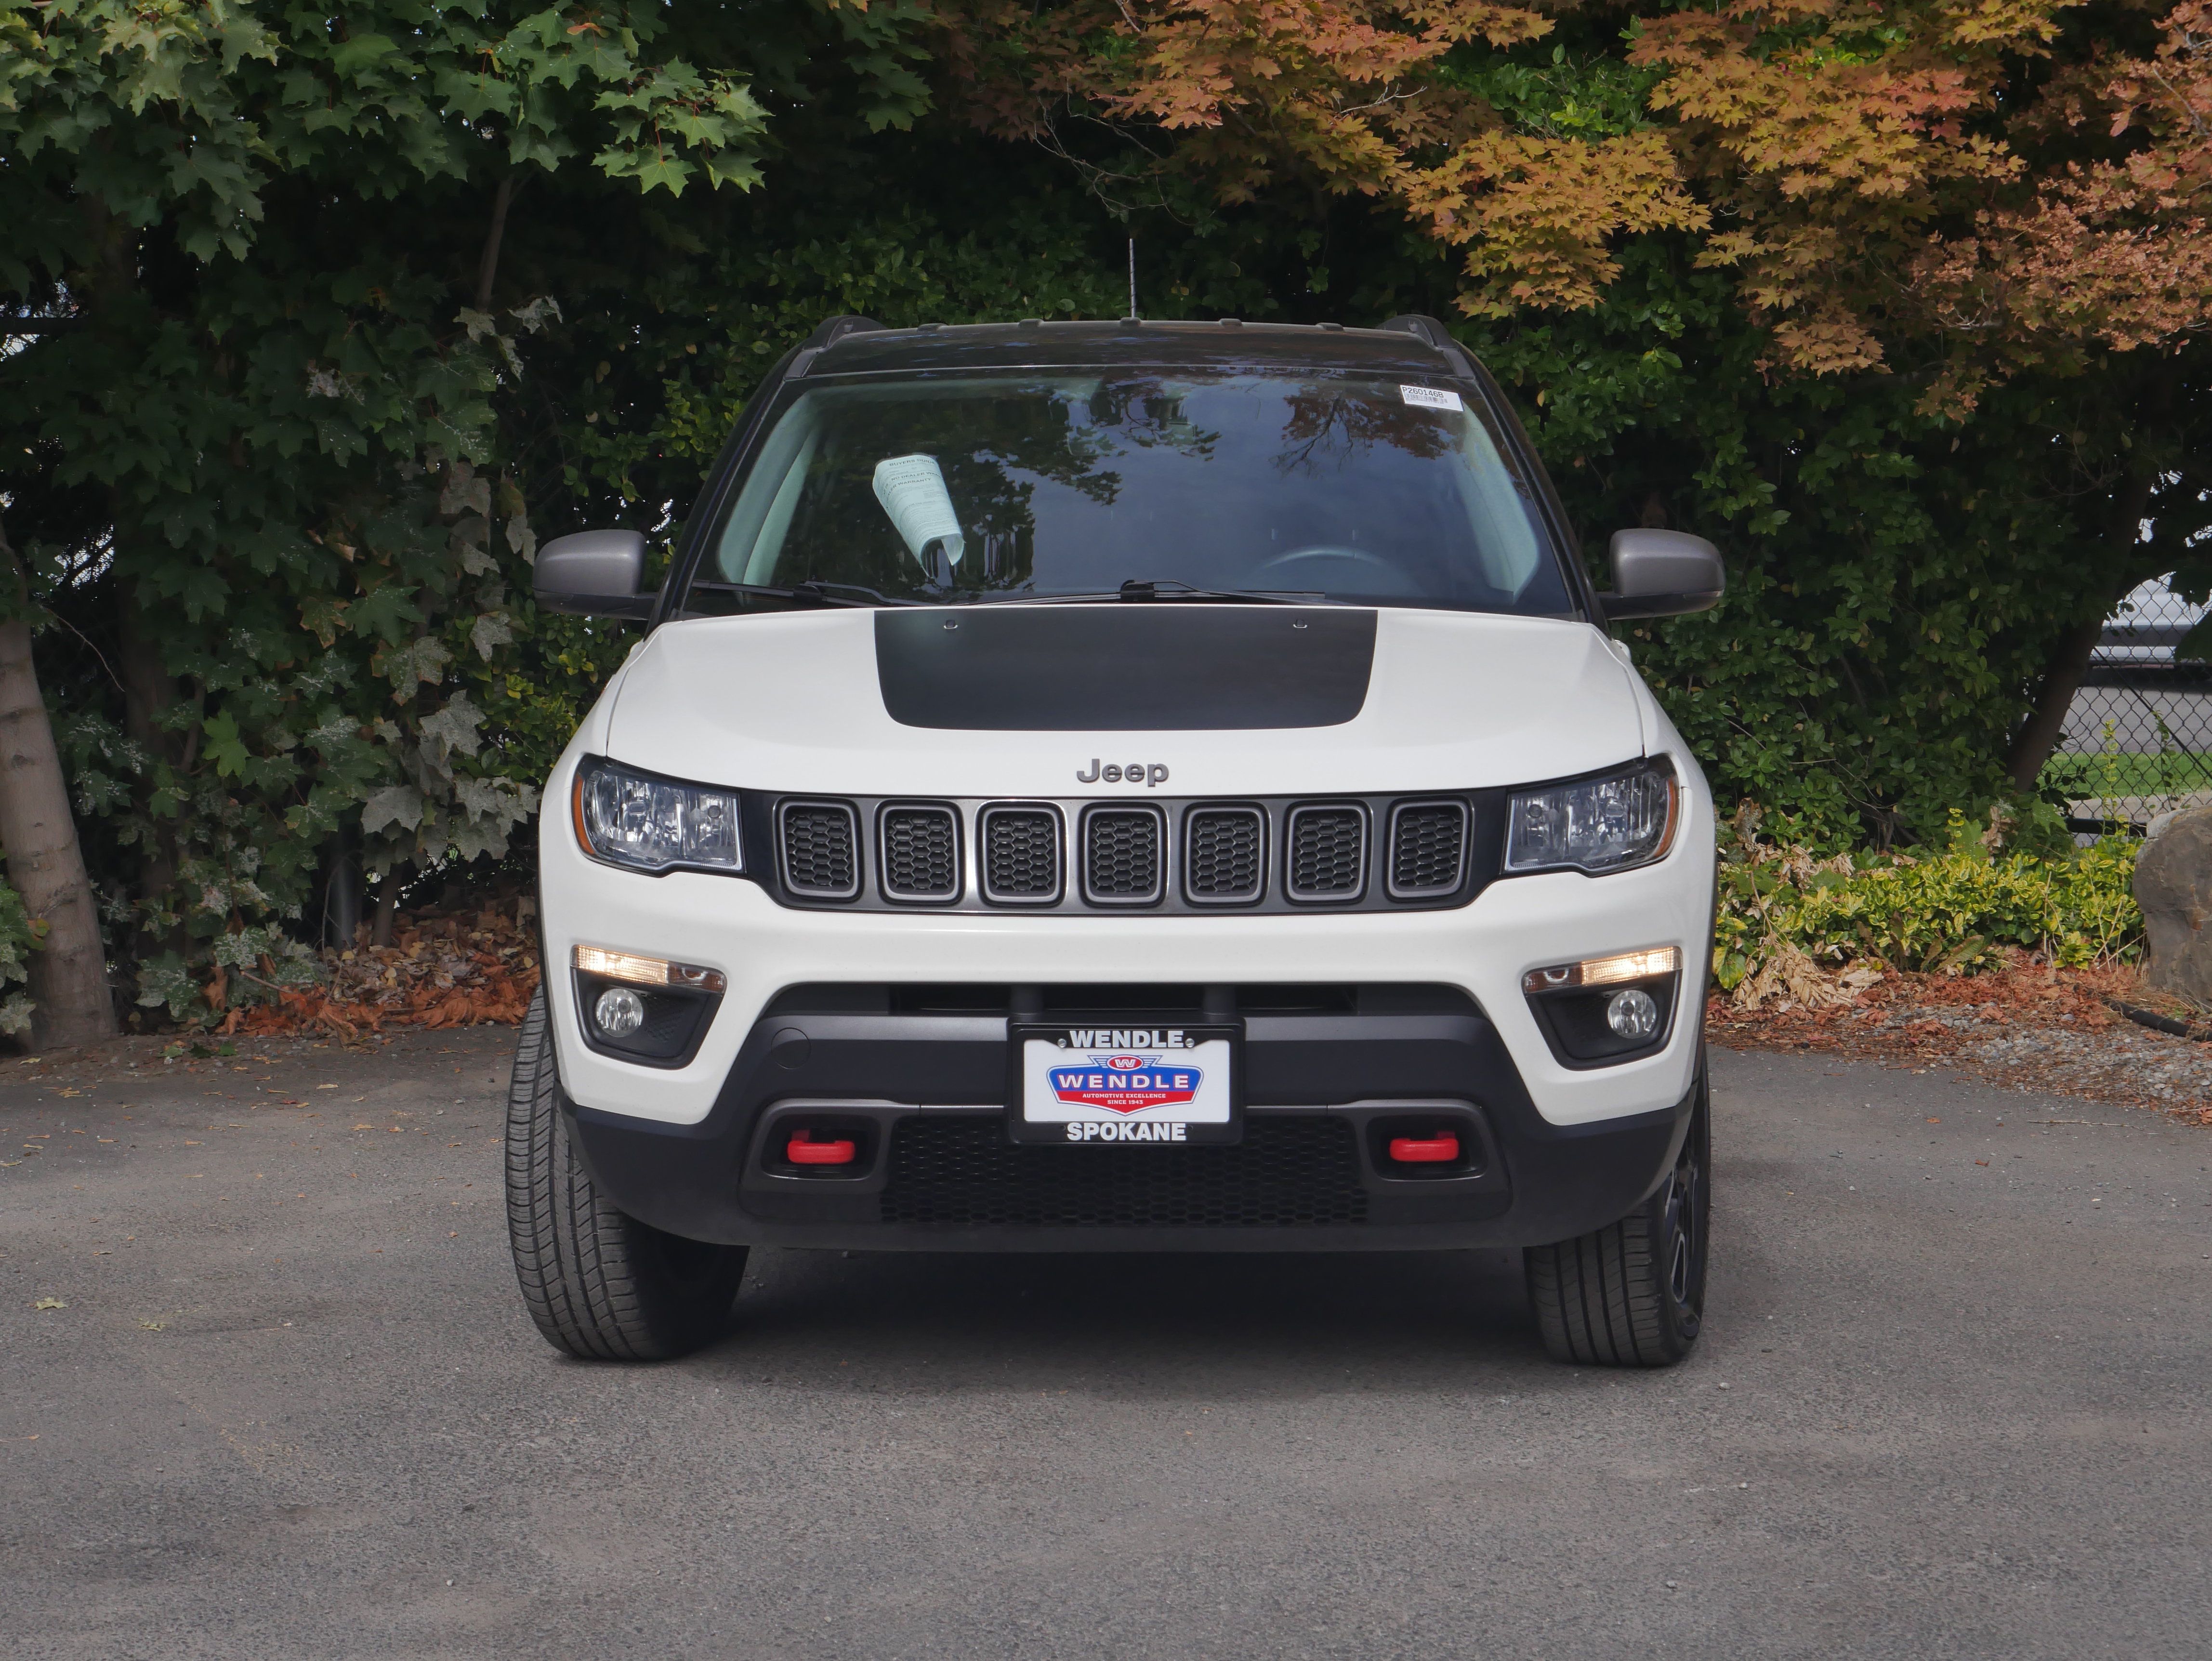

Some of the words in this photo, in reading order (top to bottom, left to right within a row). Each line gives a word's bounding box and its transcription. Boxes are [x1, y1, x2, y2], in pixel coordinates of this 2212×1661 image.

[1077, 758, 1170, 788] Jeep
[1069, 1030, 1185, 1048] WENDLE
[1058, 1075, 1189, 1089] WENDLE
[1066, 1122, 1187, 1141] SPOKANE
